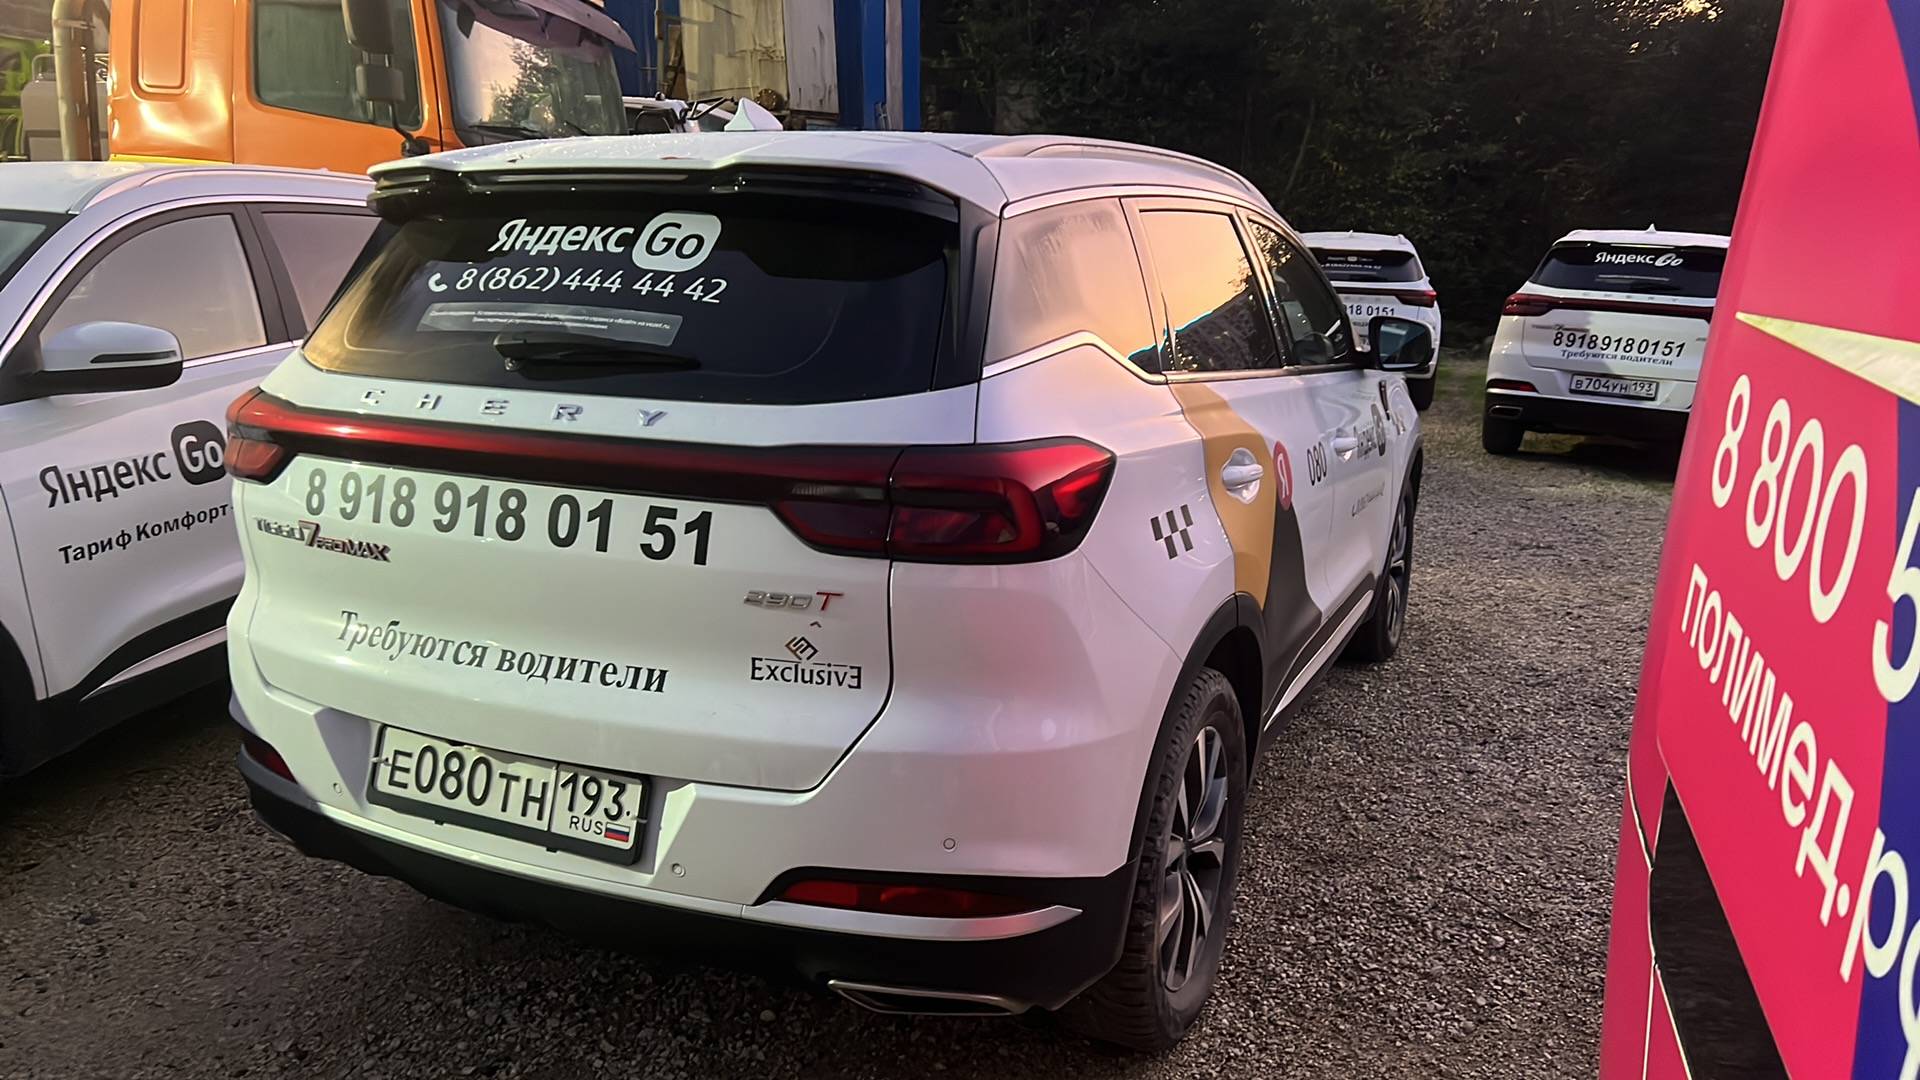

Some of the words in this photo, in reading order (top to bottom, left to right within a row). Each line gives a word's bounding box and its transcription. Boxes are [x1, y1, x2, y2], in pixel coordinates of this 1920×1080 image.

[488, 218, 635, 256] Яндекс
[644, 221, 707, 260] Go
[1594, 251, 1655, 265] Яндекс
[455, 266, 622, 293] 8(862)444
[632, 273, 675, 298] 44
[683, 277, 728, 303] 42
[1561, 349, 1618, 360] Требуются
[1620, 354, 1674, 366] водители
[360, 388, 669, 426] CHERY
[1631, 381, 1654, 393] 193
[38, 450, 172, 509] Яндекс
[178, 434, 224, 474] Go
[1306, 441, 1328, 487] 080
[306, 468, 328, 516] 8
[339, 471, 417, 528] 918
[432, 481, 528, 542] 918
[547, 494, 614, 553] 01
[639, 505, 714, 567] 51
[1711, 374, 1751, 509] 8
[1746, 398, 1868, 624] 800
[58, 523, 133, 565] Тариф
[337, 609, 490, 670] Требуются
[494, 647, 670, 695] водители
[560, 771, 628, 822] 193
[568, 815, 604, 836] RUS
